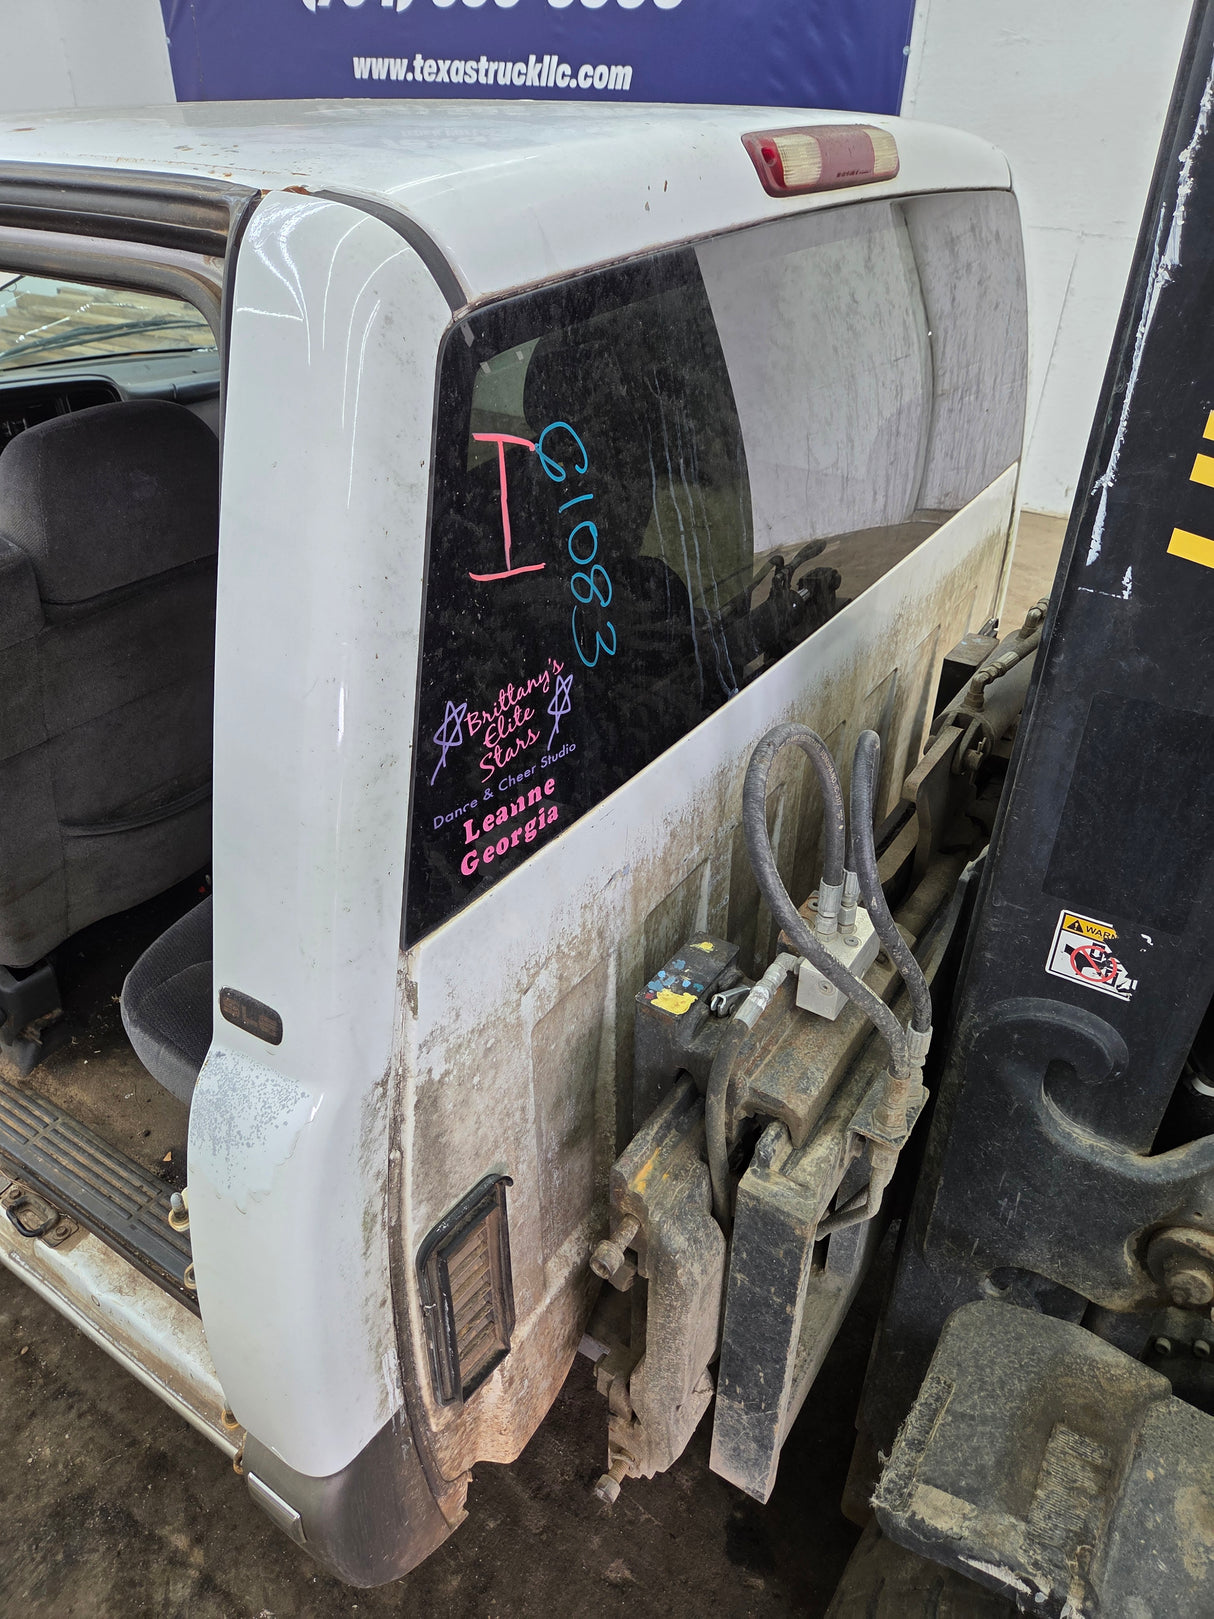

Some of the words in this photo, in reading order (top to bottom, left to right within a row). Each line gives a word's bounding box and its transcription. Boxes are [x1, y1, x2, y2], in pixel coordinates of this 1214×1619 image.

[352, 53, 634, 91] www.texastruckllc.com
[463, 657, 565, 737] Brittany's
[483, 706, 536, 749] Elite
[433, 798, 479, 831] Dance
[482, 787, 495, 801] &
[498, 764, 537, 791] Cheer
[540, 742, 577, 769] Studio
[478, 728, 541, 783] Stars
[460, 804, 559, 876] Georgia
[462, 778, 556, 845] Leanne
